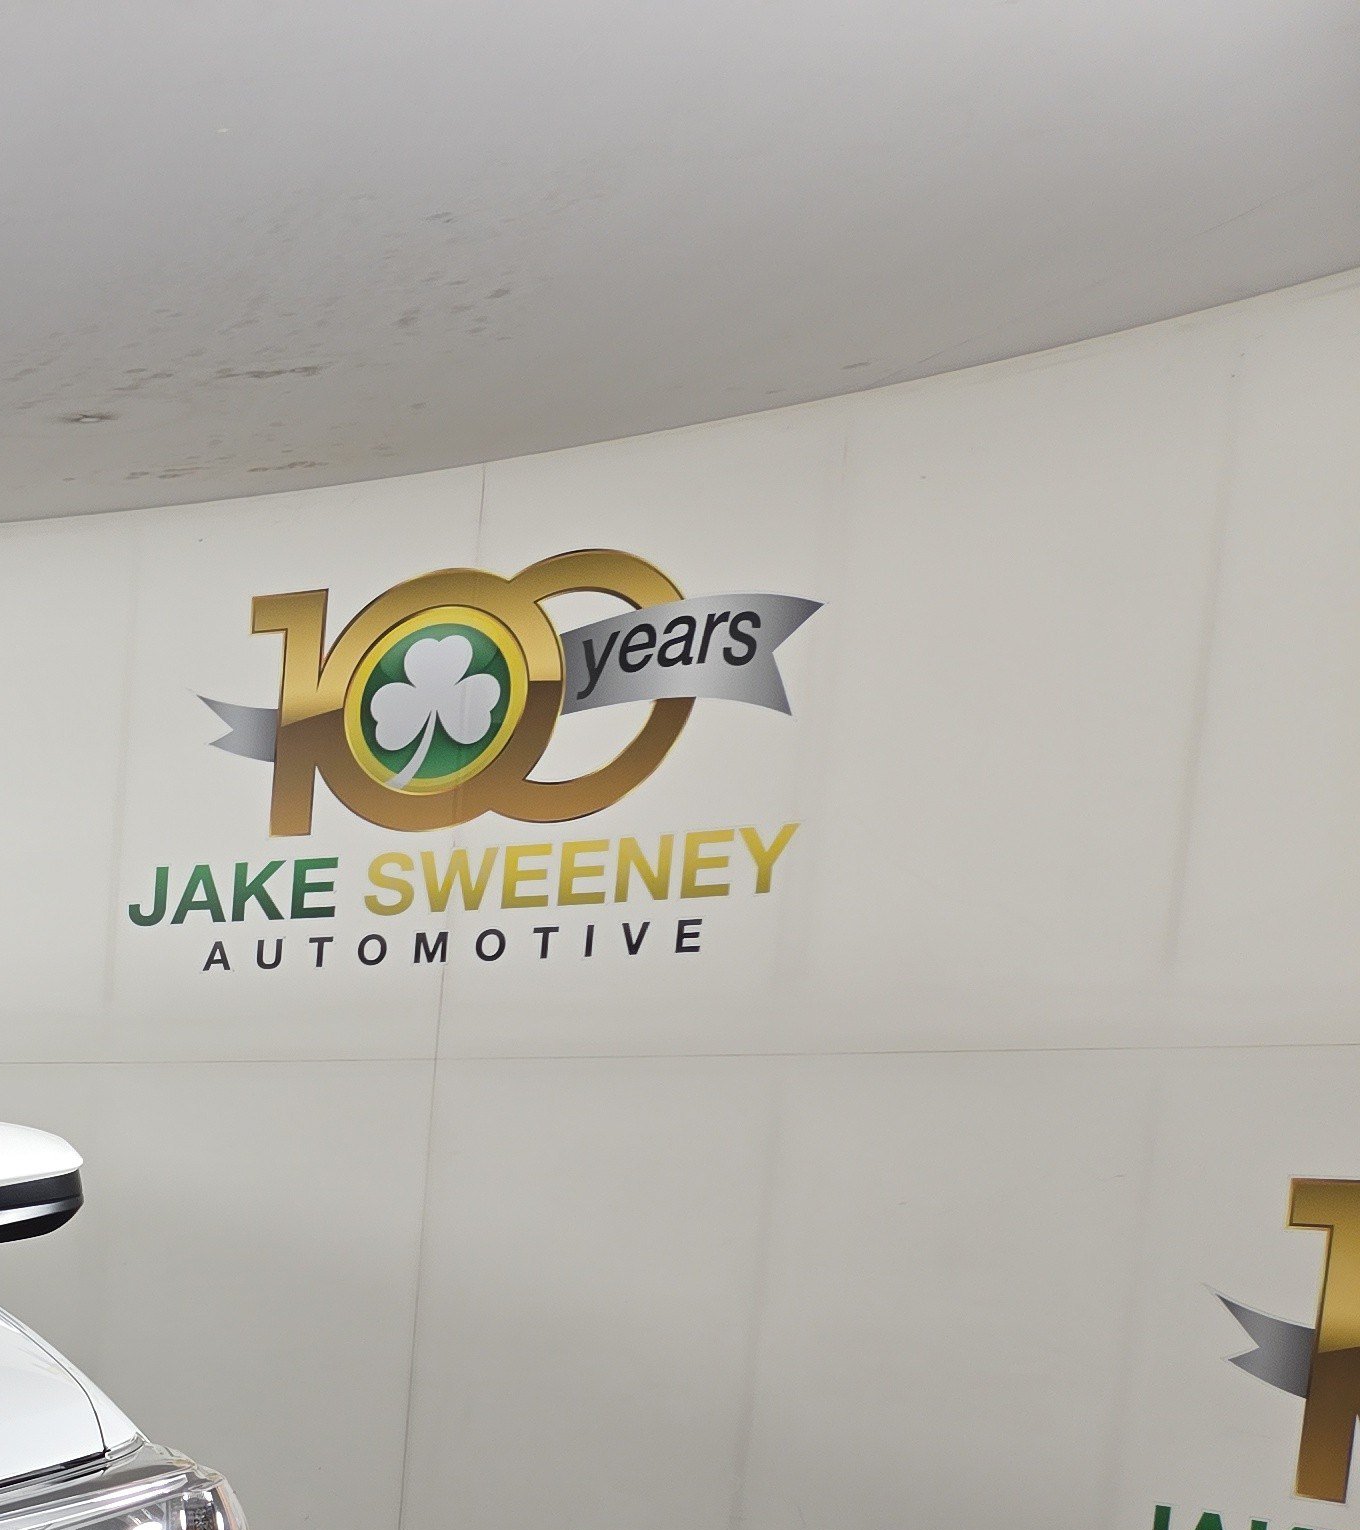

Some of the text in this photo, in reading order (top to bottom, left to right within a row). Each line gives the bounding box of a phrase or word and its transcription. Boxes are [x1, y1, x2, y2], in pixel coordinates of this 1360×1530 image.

[577, 607, 761, 700] years
[128, 822, 799, 927] JAKE SWEENEY
[203, 919, 703, 973] AUTOMOTIVE
